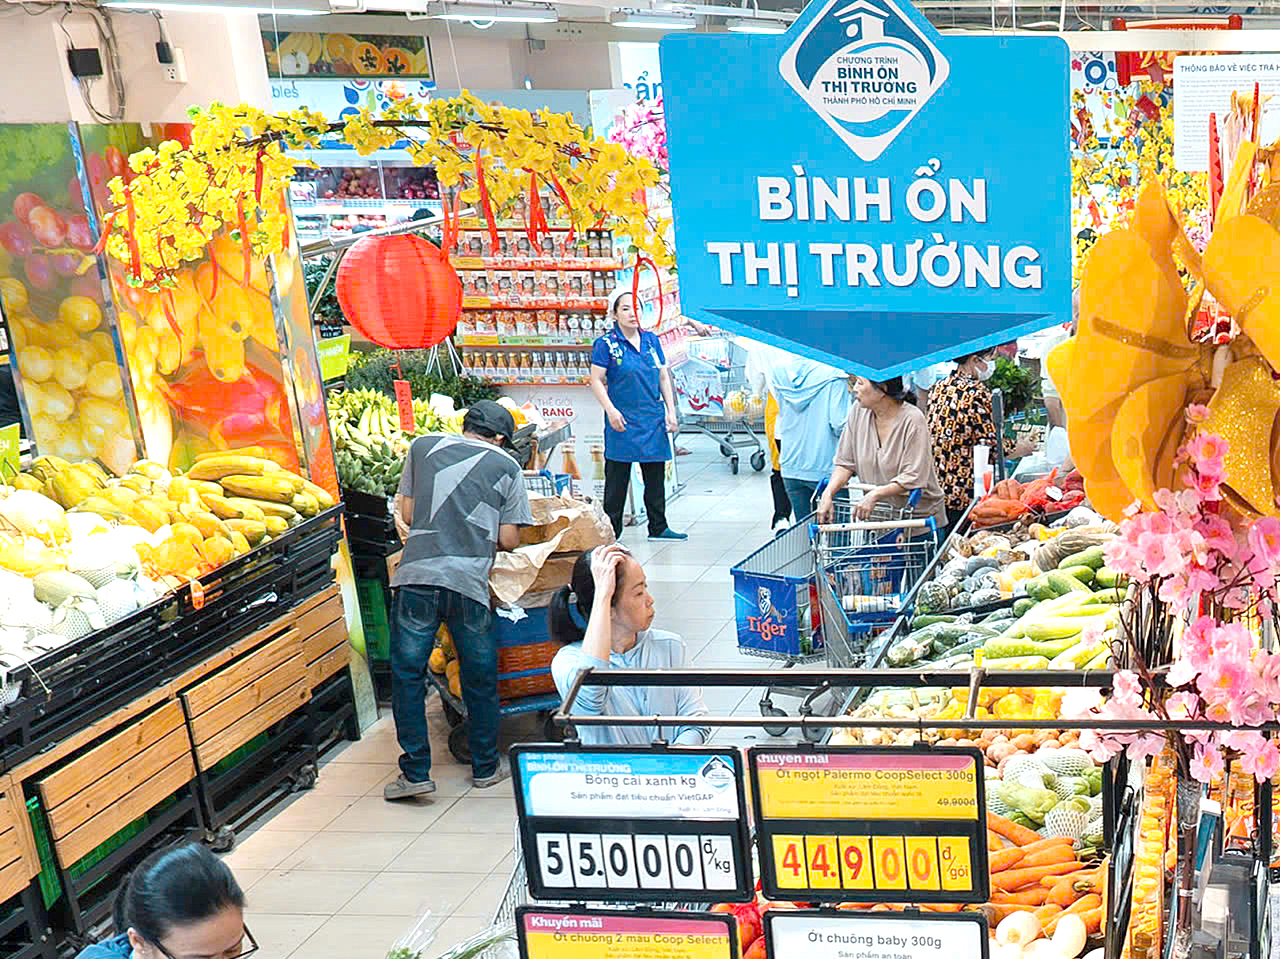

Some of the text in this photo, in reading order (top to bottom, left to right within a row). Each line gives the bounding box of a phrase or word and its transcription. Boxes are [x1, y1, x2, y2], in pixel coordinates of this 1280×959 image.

[837, 64, 874, 79] BÌNH
[821, 78, 918, 96] THỊ TRƯỜNG
[757, 158, 988, 224] BÌNH ỔN
[707, 233, 1043, 298] THỊ TRƯỜNG
[542, 407, 574, 417] RANG
[746, 615, 788, 641] Tiger
[645, 776, 677, 786] xanh
[680, 776, 697, 788] kg
[824, 769, 872, 780] Palermo
[875, 769, 943, 781] CoopSelect
[946, 770, 974, 782] 300g
[546, 840, 694, 878] 55.000
[782, 843, 931, 881] 44.900
[530, 915, 578, 930] Khuyến
[615, 933, 623, 943] 2
[653, 934, 684, 946] Coop
[687, 934, 722, 944] Select
[807, 931, 942, 949] Ớt chuông baby 300g
